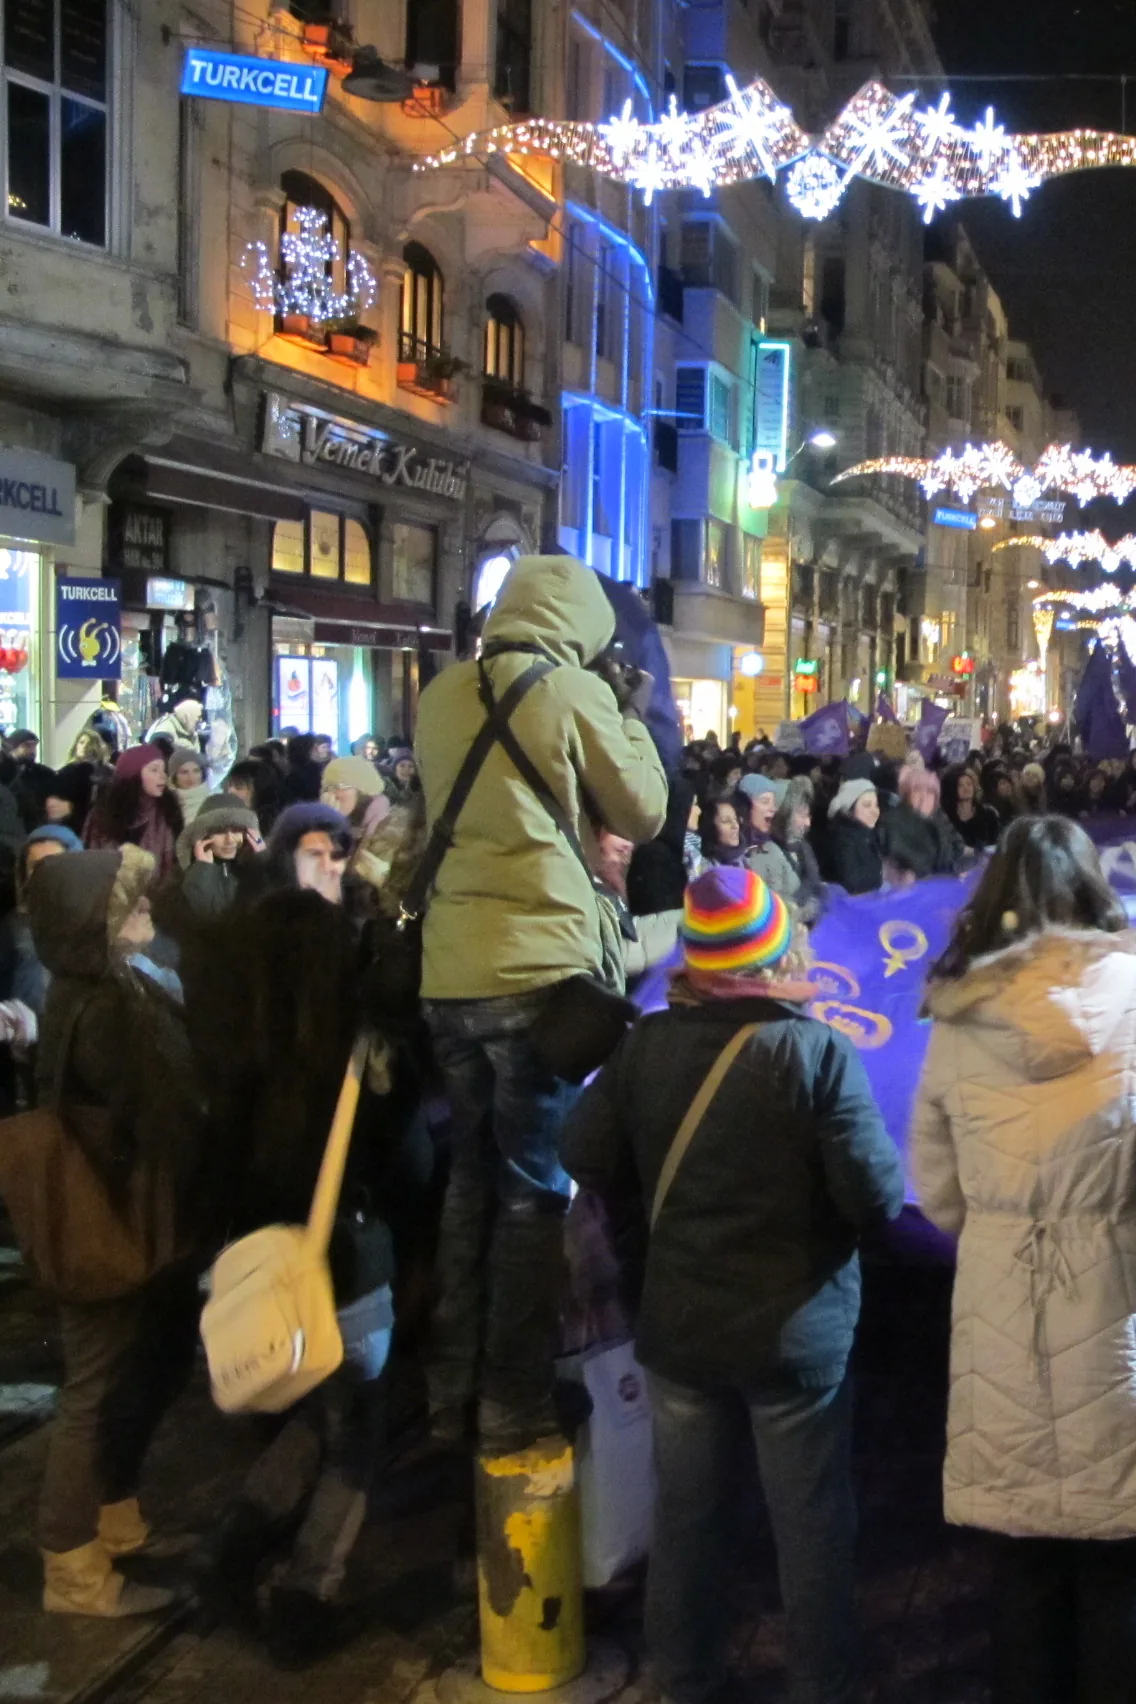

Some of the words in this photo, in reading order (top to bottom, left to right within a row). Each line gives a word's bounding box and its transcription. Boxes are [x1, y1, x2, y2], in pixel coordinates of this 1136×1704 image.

[190, 59, 318, 102] TURKCELL
[302, 415, 383, 476] Yemek
[61, 585, 117, 601] TURKCELL
